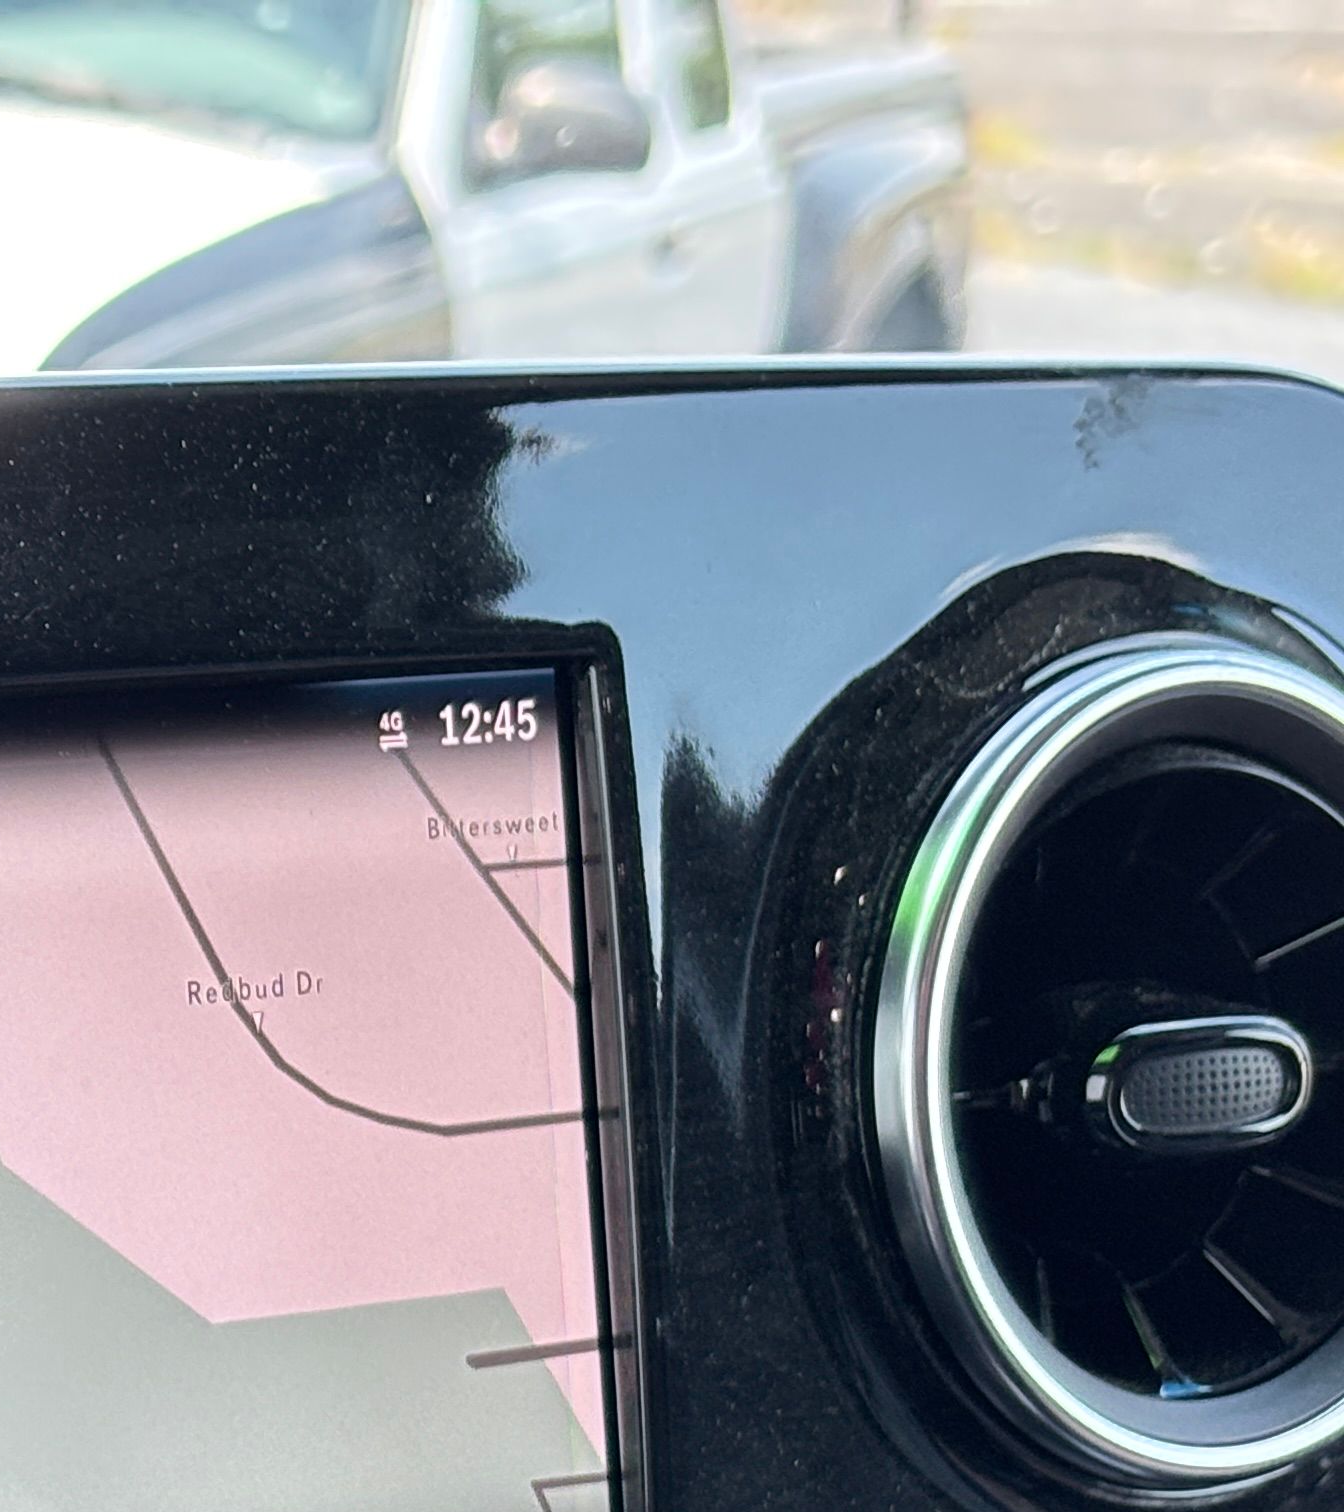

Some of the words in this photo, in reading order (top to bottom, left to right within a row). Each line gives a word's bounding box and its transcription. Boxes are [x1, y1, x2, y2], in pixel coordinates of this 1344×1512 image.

[379, 711, 404, 732] 4G
[439, 698, 537, 745] 12:45
[187, 972, 284, 1005] Redbud
[296, 970, 323, 996] Dr
